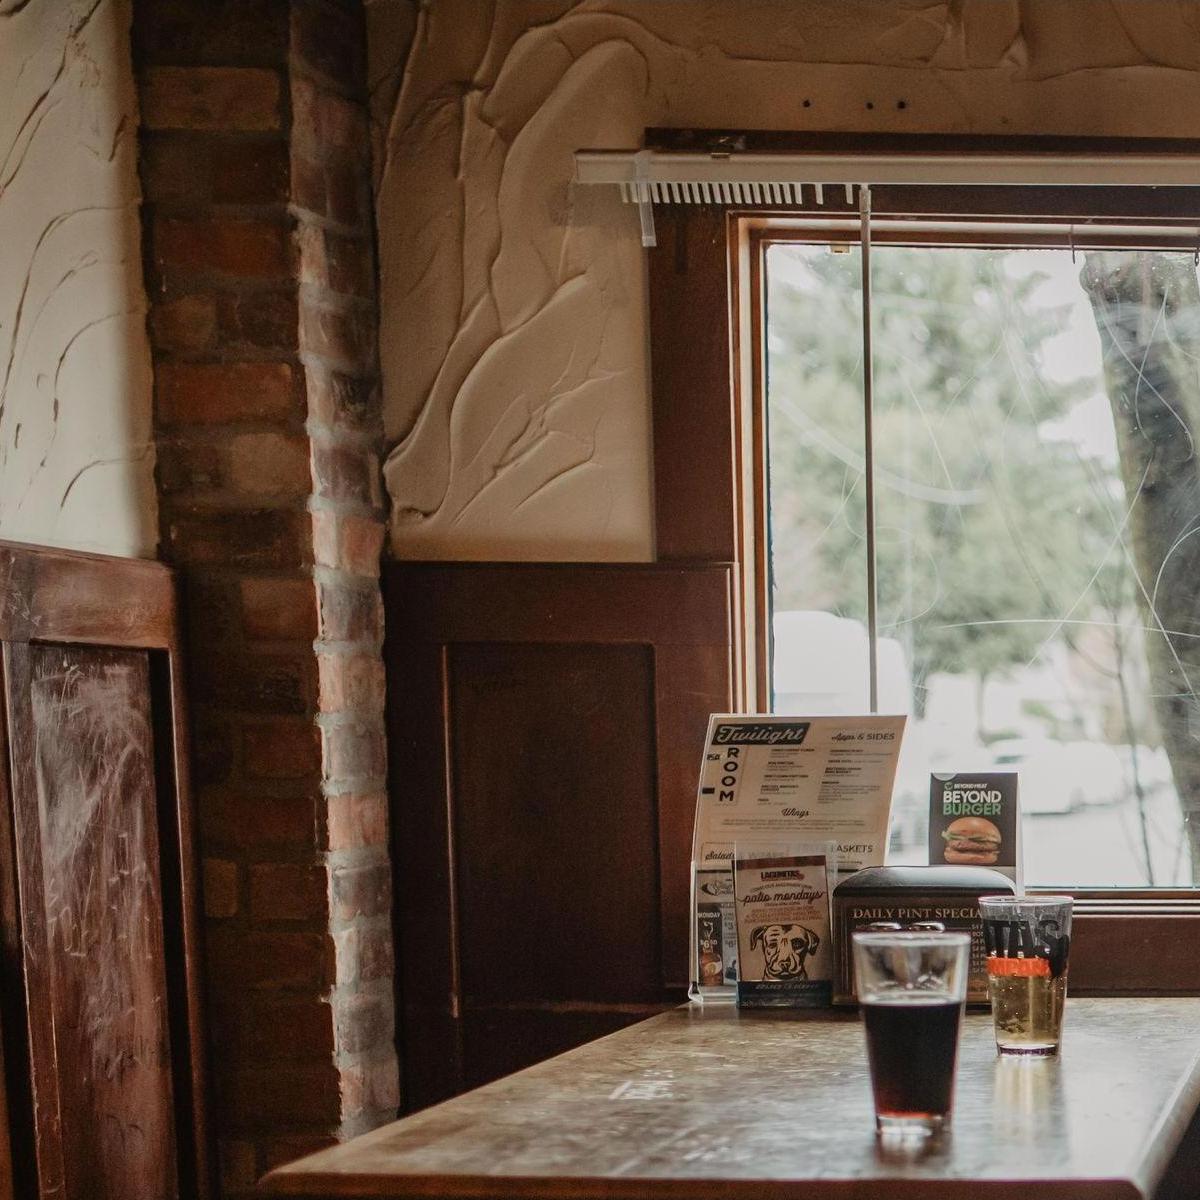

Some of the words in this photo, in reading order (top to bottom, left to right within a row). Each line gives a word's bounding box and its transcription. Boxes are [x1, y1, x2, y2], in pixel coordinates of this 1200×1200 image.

[716, 725, 804, 744] Twilight
[866, 732, 896, 741] SIDES
[943, 790, 1002, 803] BEYOND
[781, 807, 810, 819] Wings
[943, 803, 1001, 816] BURGER
[833, 844, 874, 854] ASKETS
[742, 891, 772, 907] patio
[853, 907, 895, 919] DAILY
[897, 907, 932, 919] PINT
[934, 907, 984, 919] SPECIA
